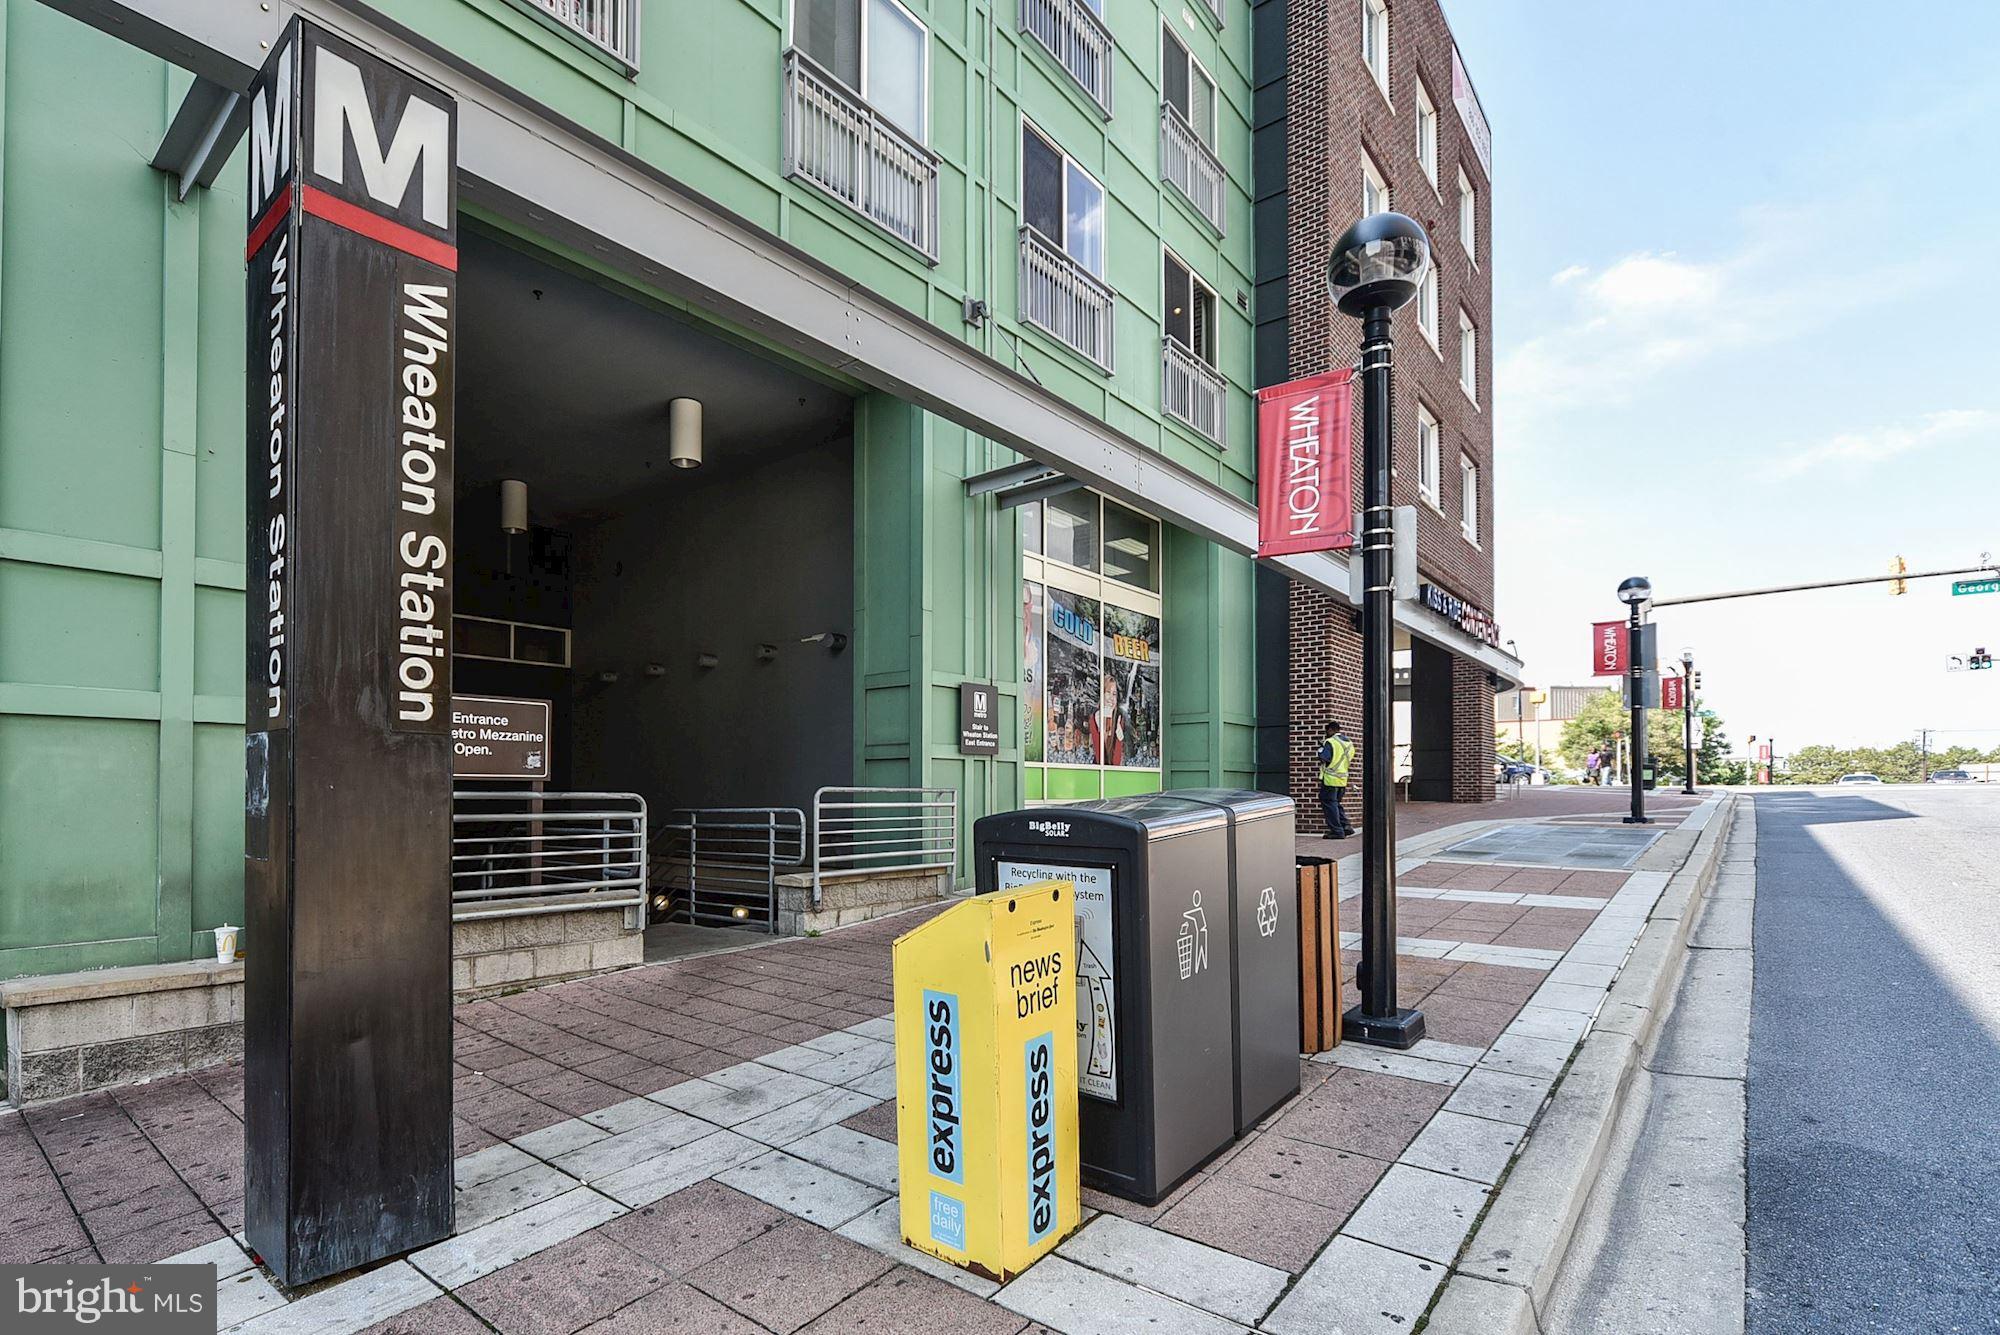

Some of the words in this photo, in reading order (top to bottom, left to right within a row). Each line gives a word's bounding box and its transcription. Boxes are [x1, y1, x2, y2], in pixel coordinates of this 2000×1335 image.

[251, 40, 292, 220] M
[314, 45, 449, 230] M
[269, 233, 287, 499] Wheaton
[401, 283, 448, 516] Wheaton
[1289, 395, 1320, 536] WHEATON
[269, 513, 285, 718] Station
[399, 531, 447, 722] Station
[1052, 602, 1094, 646] COLD
[1113, 633, 1150, 662] BEER
[1605, 626, 1617, 670] WHEATON
[452, 712, 508, 726] Entrance
[452, 728, 476, 739] etro
[480, 729, 543, 742] Mezzanine
[454, 742, 493, 757] Open.
[977, 739, 995, 747] Entrance
[1028, 821, 1071, 833] BigBelly
[1011, 867, 1053, 880] Recycling
[1055, 872, 1077, 882] with
[1080, 873, 1097, 884] the
[1073, 890, 1104, 901] ystem
[1010, 952, 1061, 988] news
[1016, 976, 1059, 1019] brief
[928, 999, 960, 1174] express
[1088, 1079, 1111, 1090] CLEAN
[1030, 1043, 1055, 1235] express
[932, 1212, 962, 1237] daily
[934, 1196, 959, 1218] free
